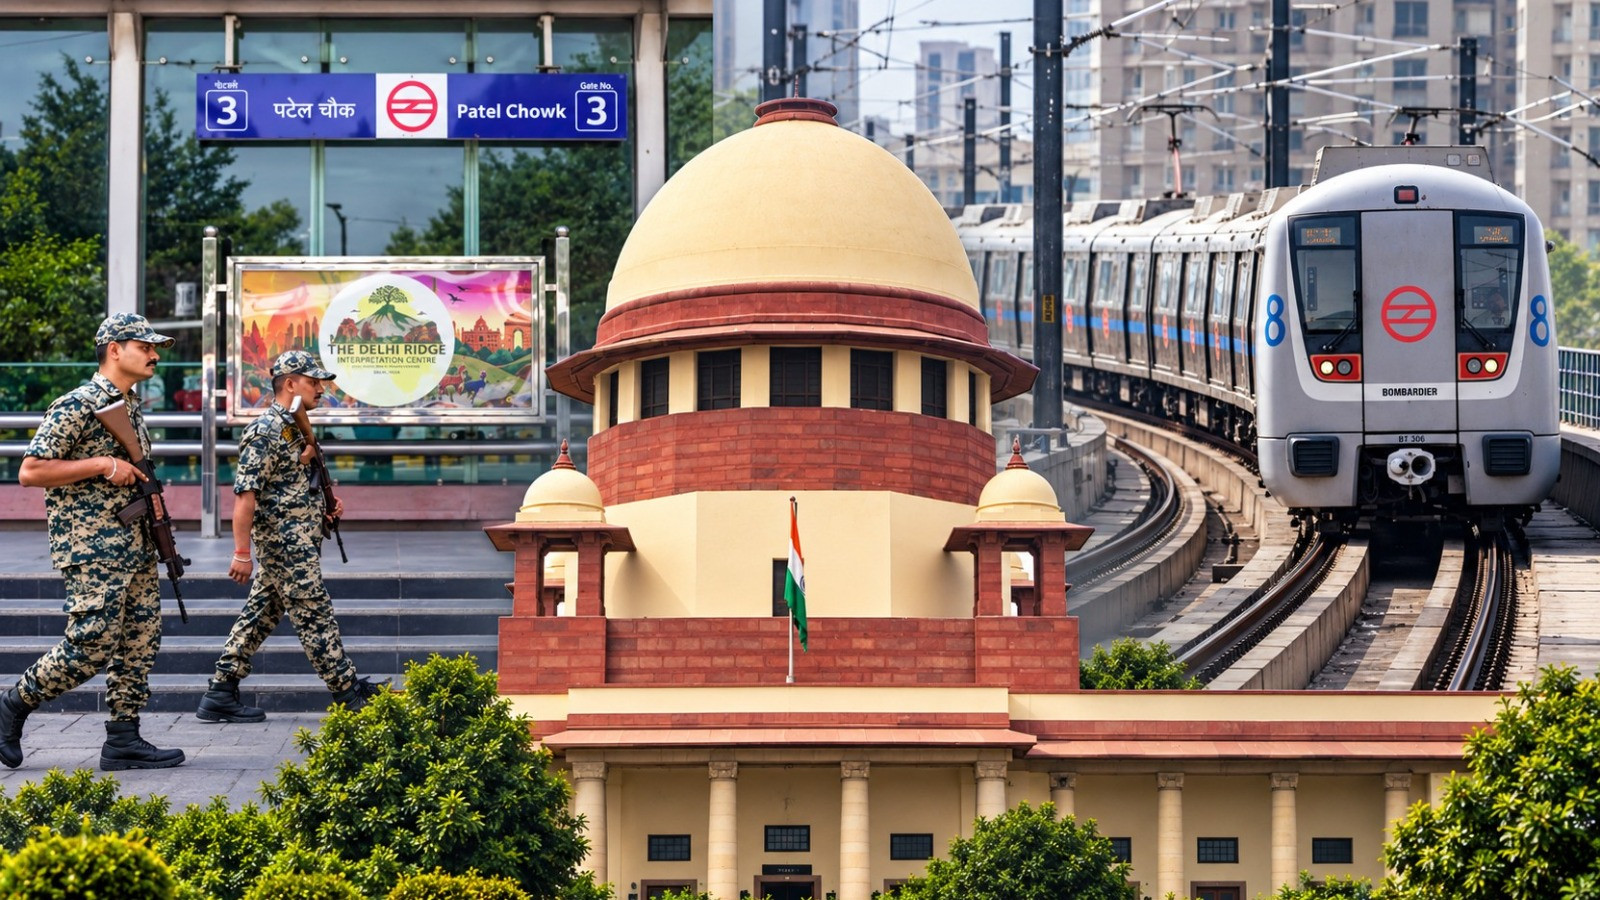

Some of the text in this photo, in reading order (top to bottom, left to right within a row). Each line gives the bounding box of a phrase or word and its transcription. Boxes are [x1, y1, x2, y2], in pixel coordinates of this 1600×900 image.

[580, 82, 614, 90] Gate No.
[216, 95, 238, 126] 3
[273, 96, 357, 119] पटेल चौक
[457, 103, 567, 119] Patel Chowk
[586, 95, 608, 126] 3
[1264, 293, 1286, 347] 8
[1529, 294, 1551, 347] 8
[328, 344, 446, 355] THE DELHI RIDGE
[337, 356, 437, 364] INTERPRETATION CENTRE
[1382, 387, 1438, 397] BOMBARDIER
